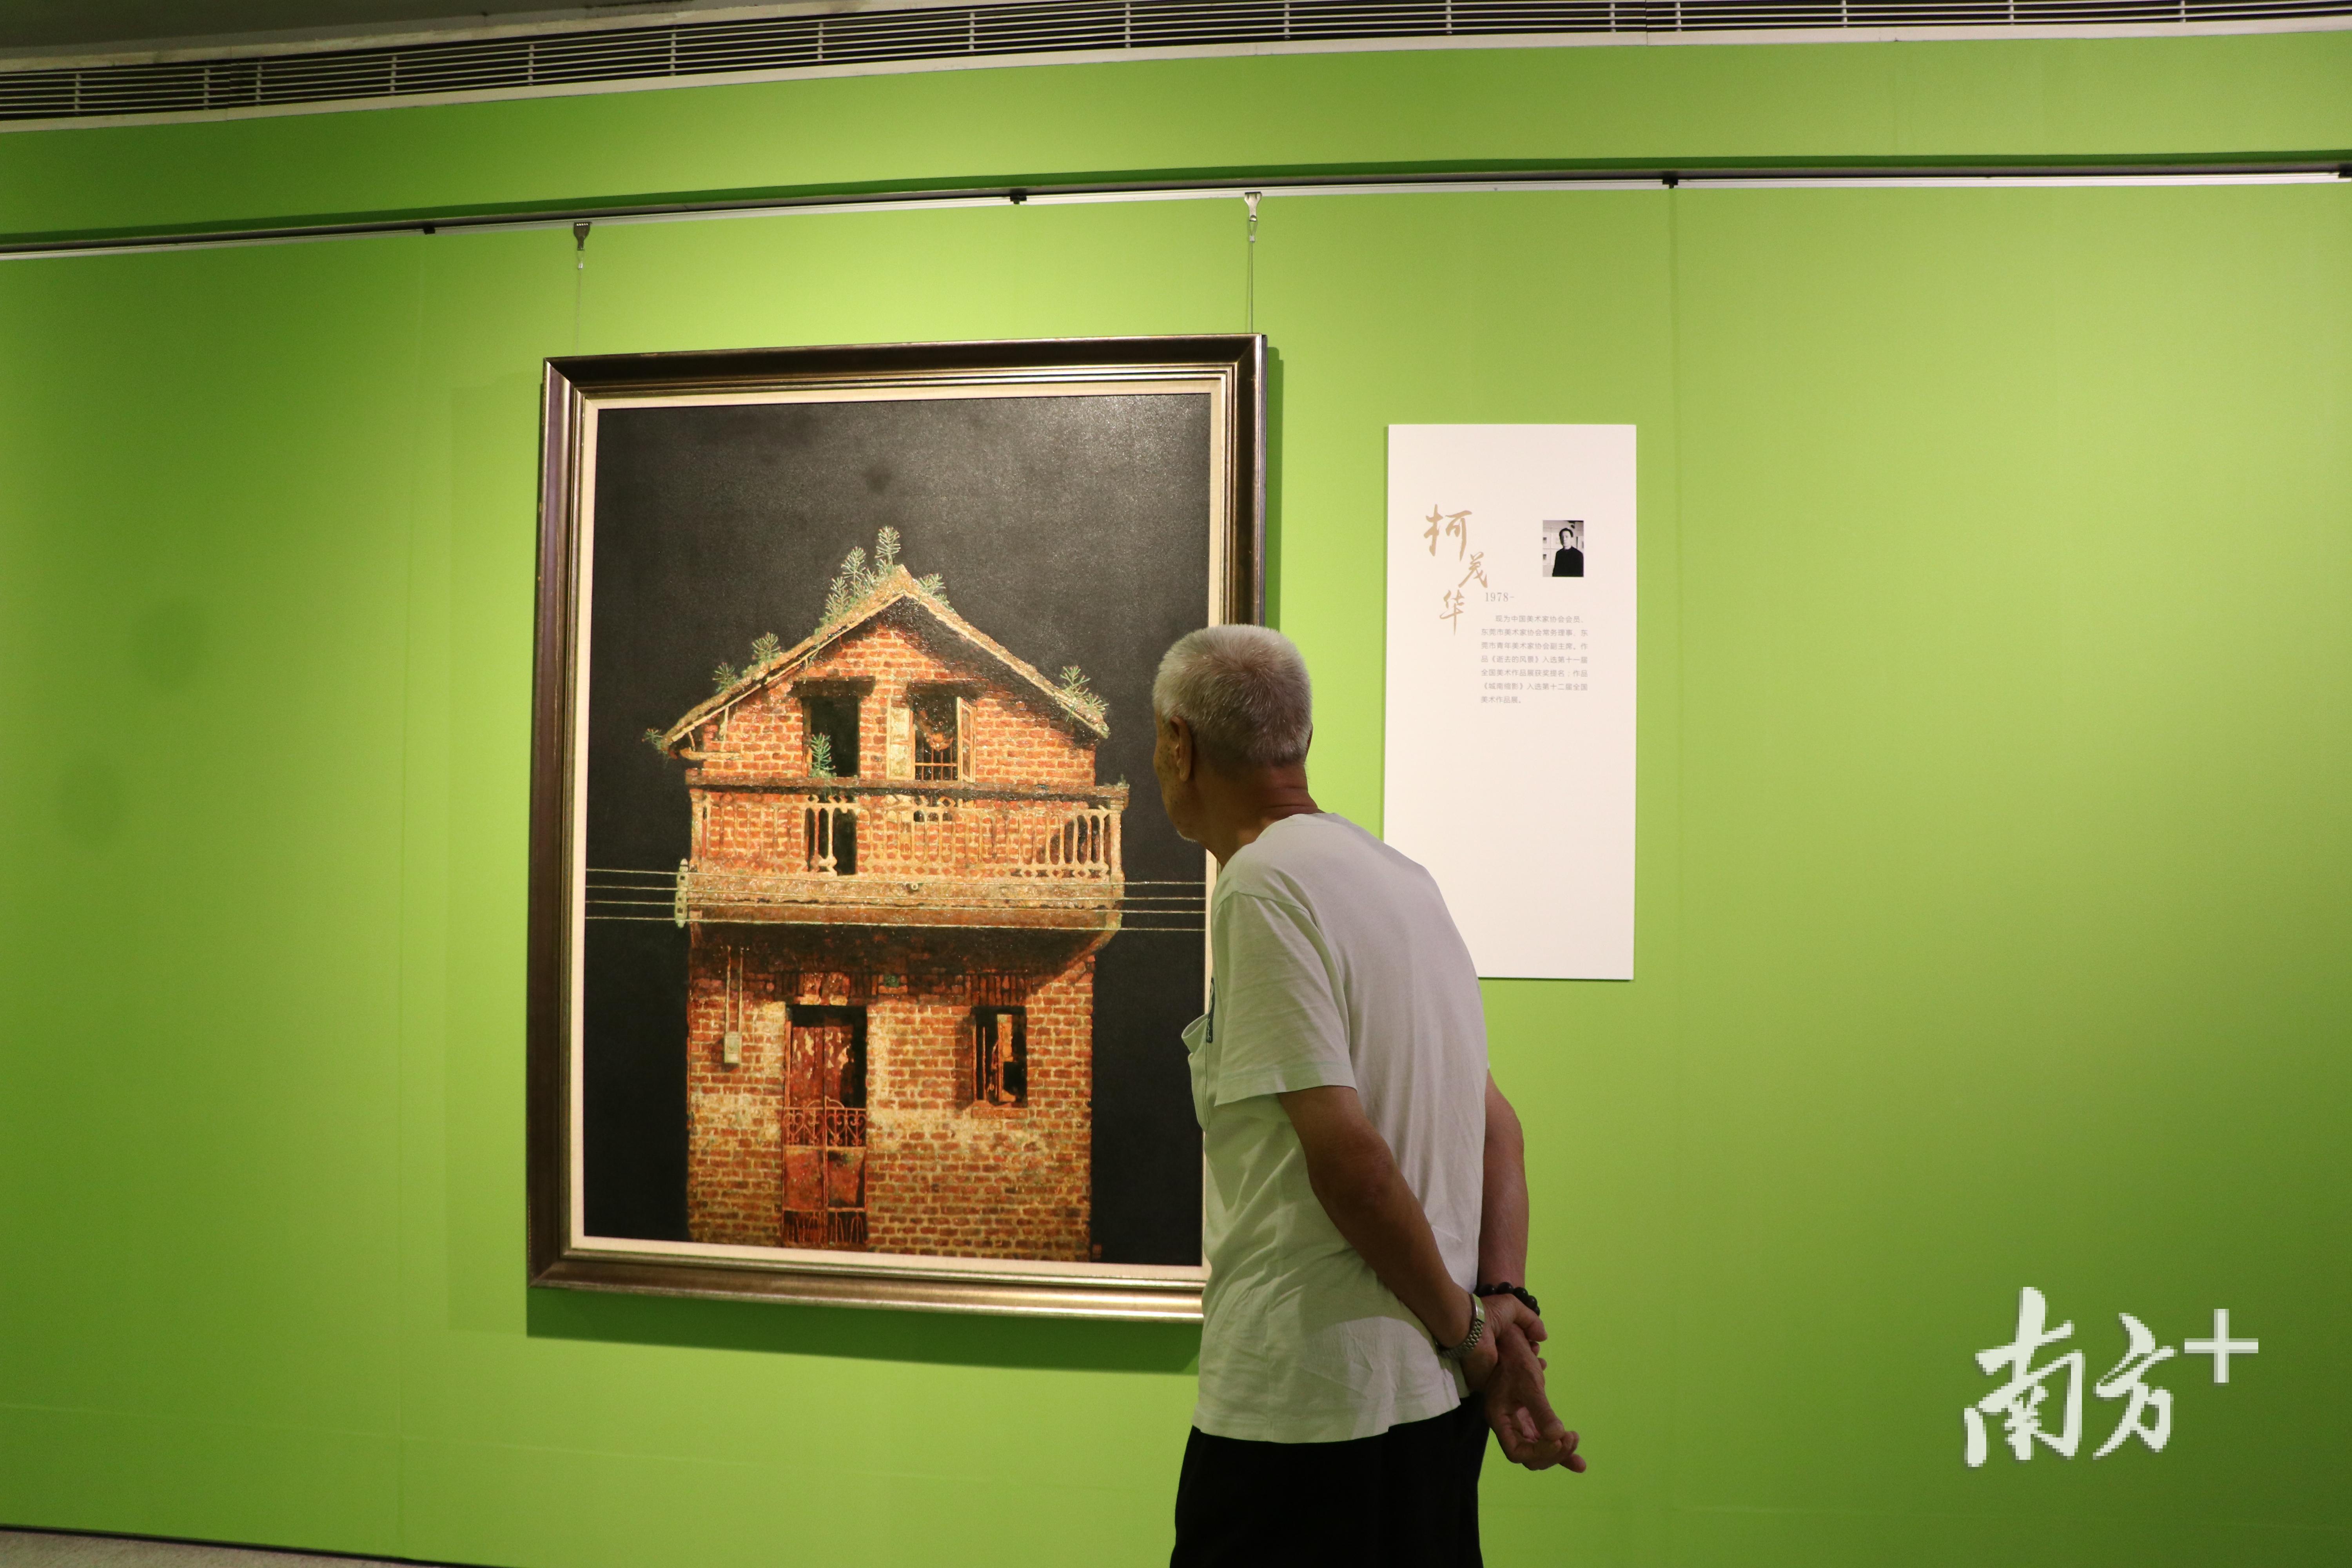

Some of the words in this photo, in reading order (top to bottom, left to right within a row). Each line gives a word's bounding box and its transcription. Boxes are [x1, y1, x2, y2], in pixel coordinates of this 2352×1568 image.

[1485, 592, 1515, 602] 1978-
[1481, 696, 1521, 704] 美术作品展。
